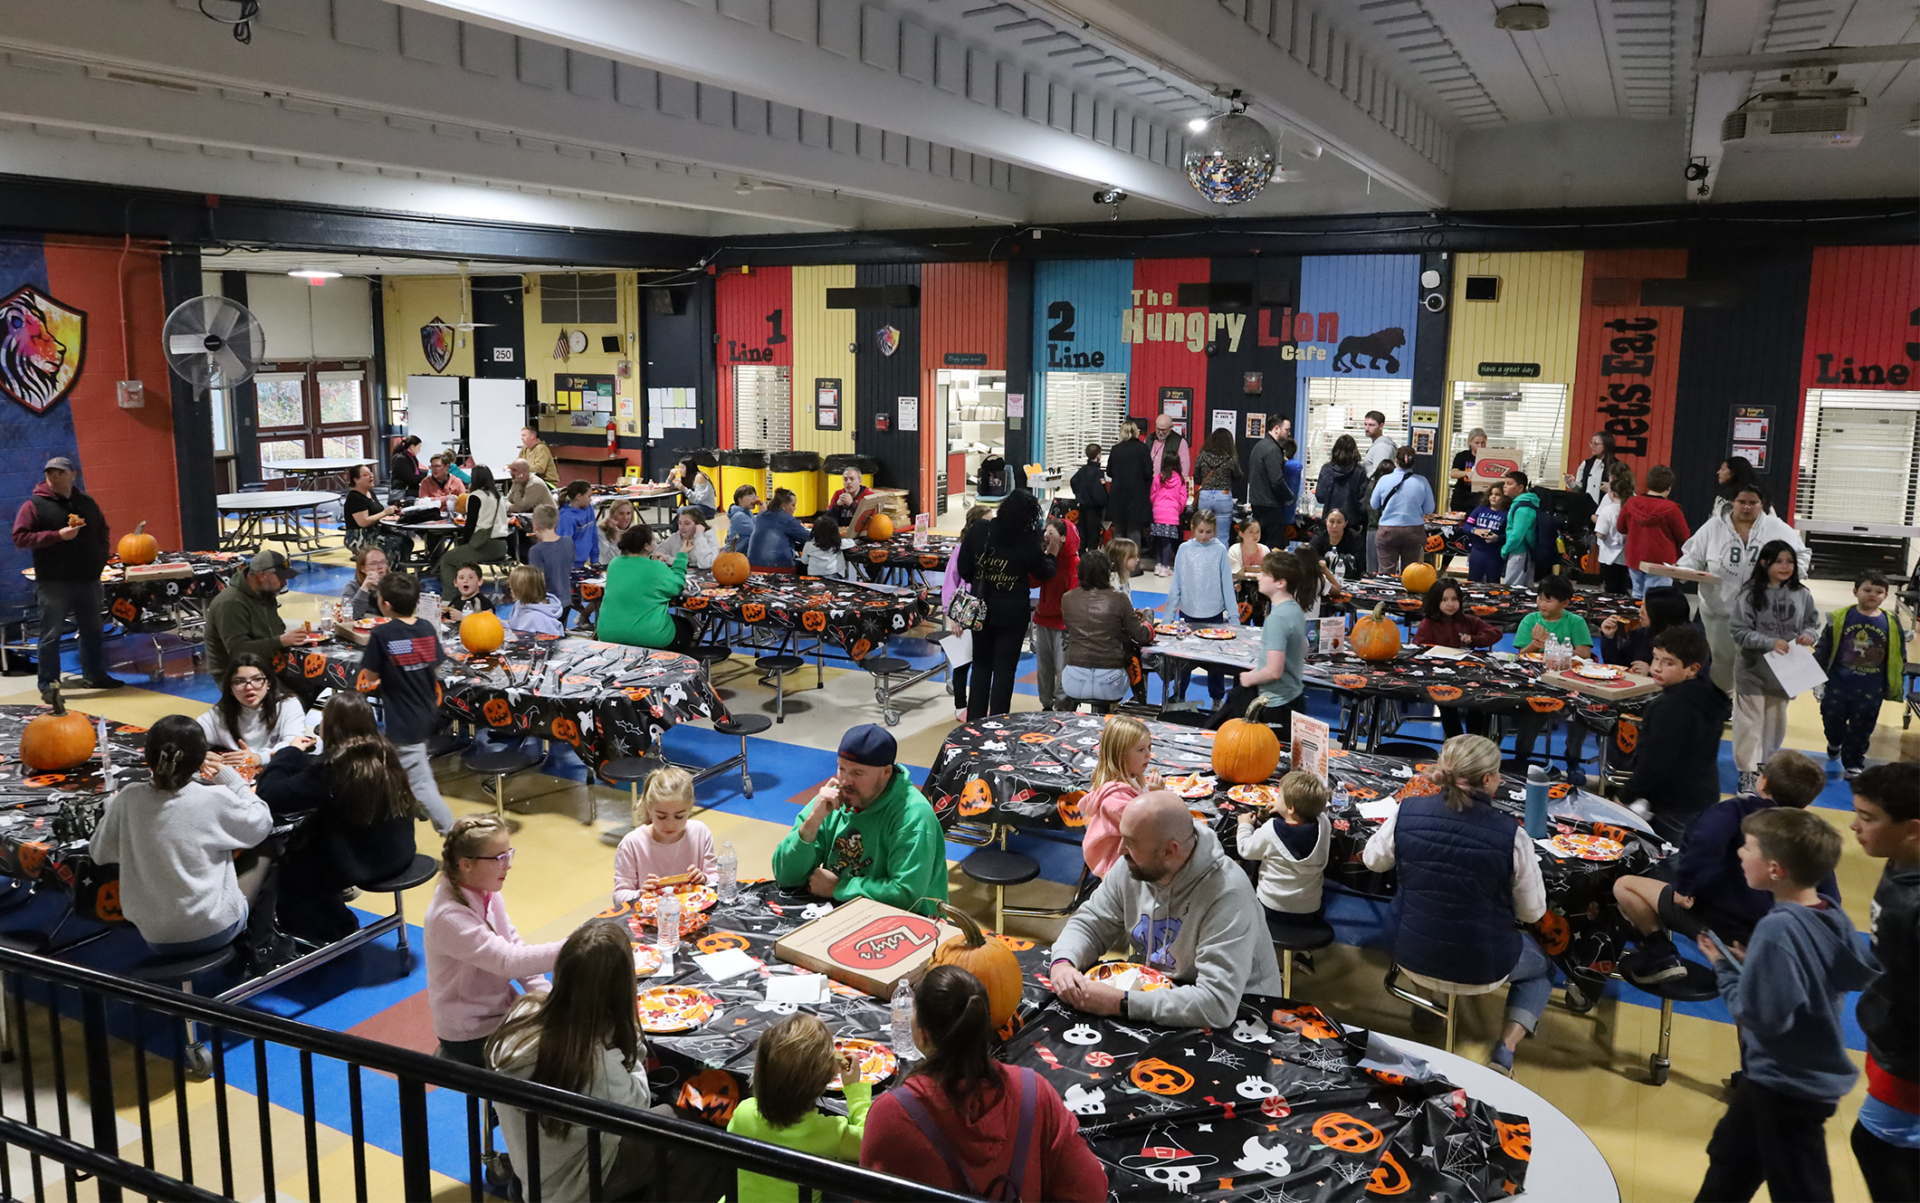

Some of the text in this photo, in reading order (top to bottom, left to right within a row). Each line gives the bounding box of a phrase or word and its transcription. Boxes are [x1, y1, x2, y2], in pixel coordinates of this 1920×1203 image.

[1131, 289, 1173, 306] The
[766, 309, 787, 345] 1
[1048, 301, 1075, 341] 2
[1121, 307, 1339, 353] Hungry Lion
[495, 349, 512, 360] 250
[728, 340, 774, 362] Line
[1047, 344, 1105, 368] Line
[1281, 345, 1327, 361] Cafe
[1601, 317, 1658, 377] Eat
[1481, 365, 1496, 373] Have
[1503, 365, 1521, 376] great
[1521, 366, 1535, 376] day
[1816, 353, 1910, 386] Line
[1597, 383, 1652, 457] Let's
